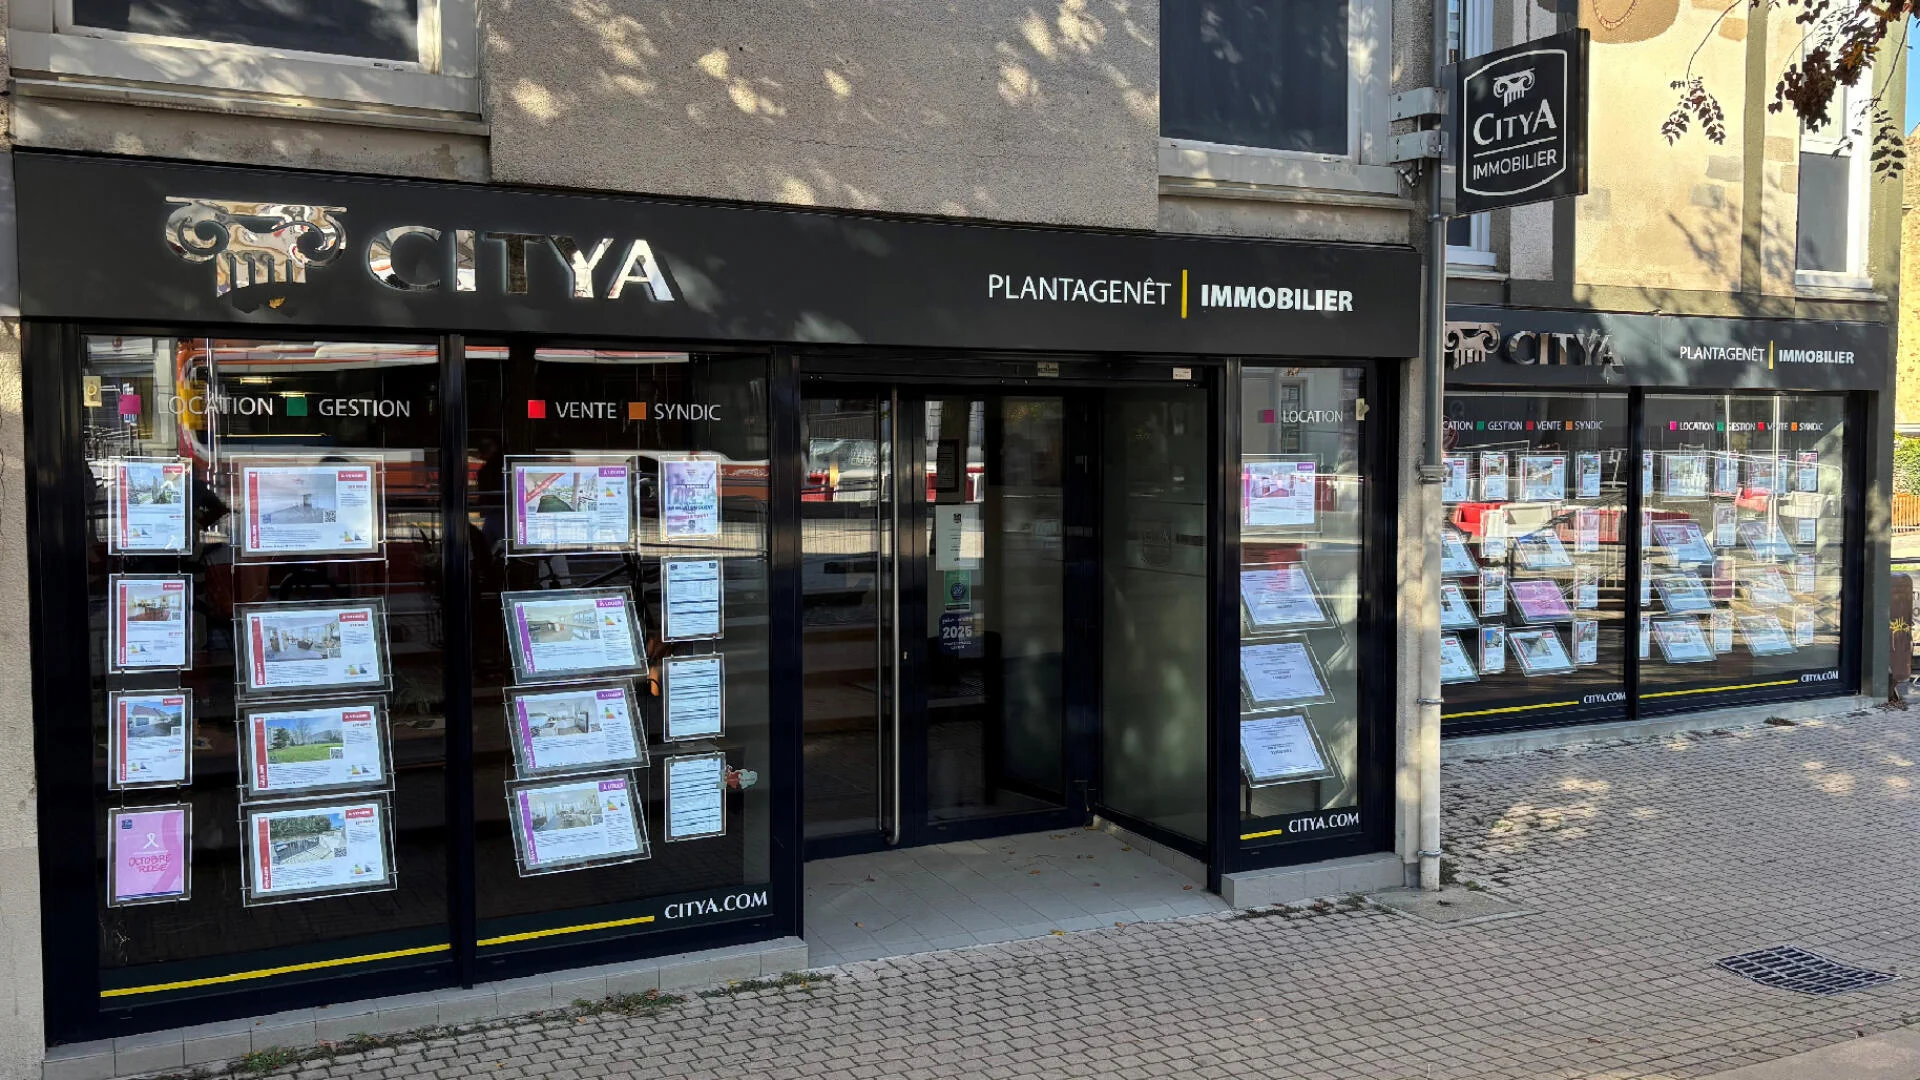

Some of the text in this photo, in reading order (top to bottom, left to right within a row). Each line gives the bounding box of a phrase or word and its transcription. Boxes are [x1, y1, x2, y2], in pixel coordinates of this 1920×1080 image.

[1472, 148, 1558, 181] IMMOBILIER
[366, 225, 676, 303] CITYA
[987, 273, 1354, 312] PLANTAGENÊT IMMOBILIER
[1507, 330, 1625, 367] CITYA
[1679, 345, 1855, 365] PLANTAGENÊT IMMOBILIER
[157, 396, 411, 418] LOCATION GESTION
[555, 401, 722, 421] VENTE SYNDIC
[1282, 409, 1344, 423] LOCATION
[1443, 420, 1604, 431] CATION GESTION VENTE SYNDIC
[1679, 421, 1715, 431] LOCATION
[1800, 670, 1839, 683] CITYA.COM
[1583, 691, 1627, 704] CITYA.COM
[1288, 811, 1360, 833] CITYA.COM
[663, 890, 769, 919] CITYA.COM
